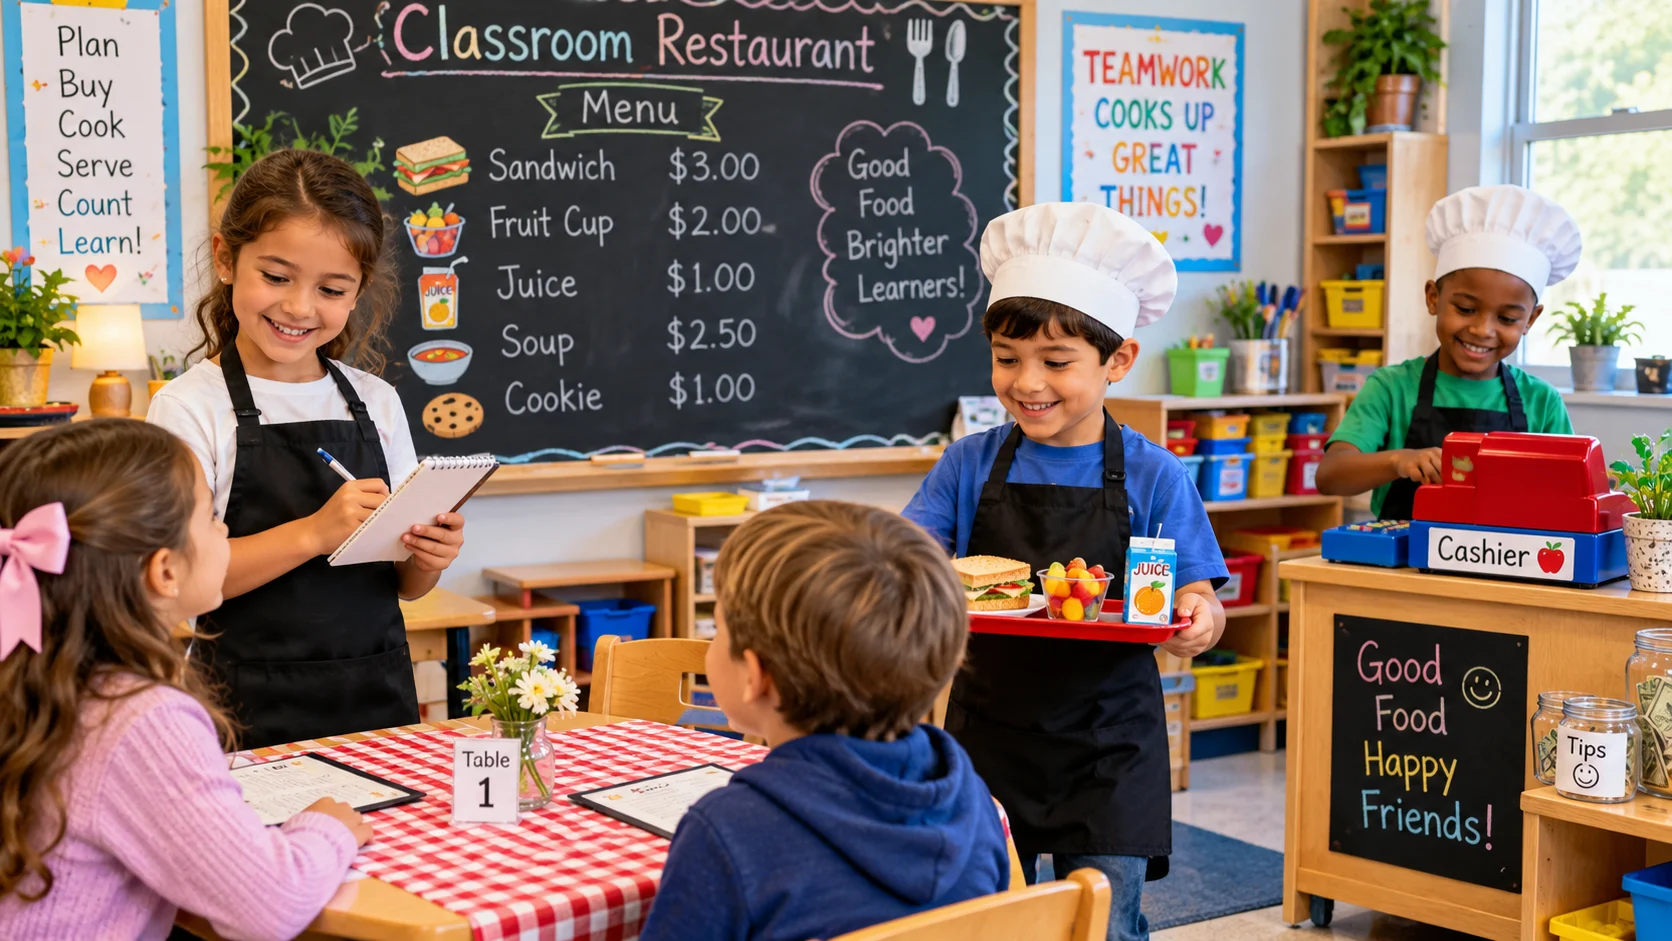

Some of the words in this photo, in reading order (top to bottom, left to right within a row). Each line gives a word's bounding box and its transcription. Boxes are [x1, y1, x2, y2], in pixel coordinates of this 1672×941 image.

[58, 25, 119, 57] Plan
[393, 2, 634, 63] Classroom
[657, 13, 876, 73] Restaurant
[1084, 50, 1226, 89] TEAMWORK
[59, 69, 112, 108] Buy
[59, 110, 125, 138] Cook
[582, 90, 679, 125] Menu
[1095, 98, 1172, 130] COOKS
[1185, 102, 1213, 131] UP
[58, 149, 133, 177] Serve
[489, 148, 615, 181] Sandwich
[670, 147, 759, 184] $3.00
[849, 148, 909, 179] Good
[1113, 141, 1196, 174] GREAT
[58, 189, 132, 216] Count
[860, 187, 914, 217] Food
[1100, 185, 1206, 218] THINGS!
[59, 226, 140, 254] Learn!
[490, 206, 551, 238] Fruit
[565, 205, 613, 246] Cup
[669, 202, 761, 239] $2.00
[847, 228, 948, 268] Brighter
[425, 286, 453, 297] JUICE
[497, 265, 577, 299] Juice
[668, 260, 754, 297] $1.00
[858, 266, 966, 303] Learners!
[502, 324, 573, 366] Soup
[668, 317, 756, 354] $2.50
[506, 380, 602, 414] Cookie
[670, 372, 755, 409] $1.00
[1436, 535, 1530, 568] Cashier
[1133, 562, 1170, 577] JUICE
[1357, 640, 1442, 685] Good
[1376, 695, 1447, 735] Food
[462, 751, 509, 768] Table
[1567, 736, 1607, 762] Tips
[1363, 740, 1458, 797] Happy
[479, 777, 494, 808] 1
[1361, 788, 1493, 851] Friends!
